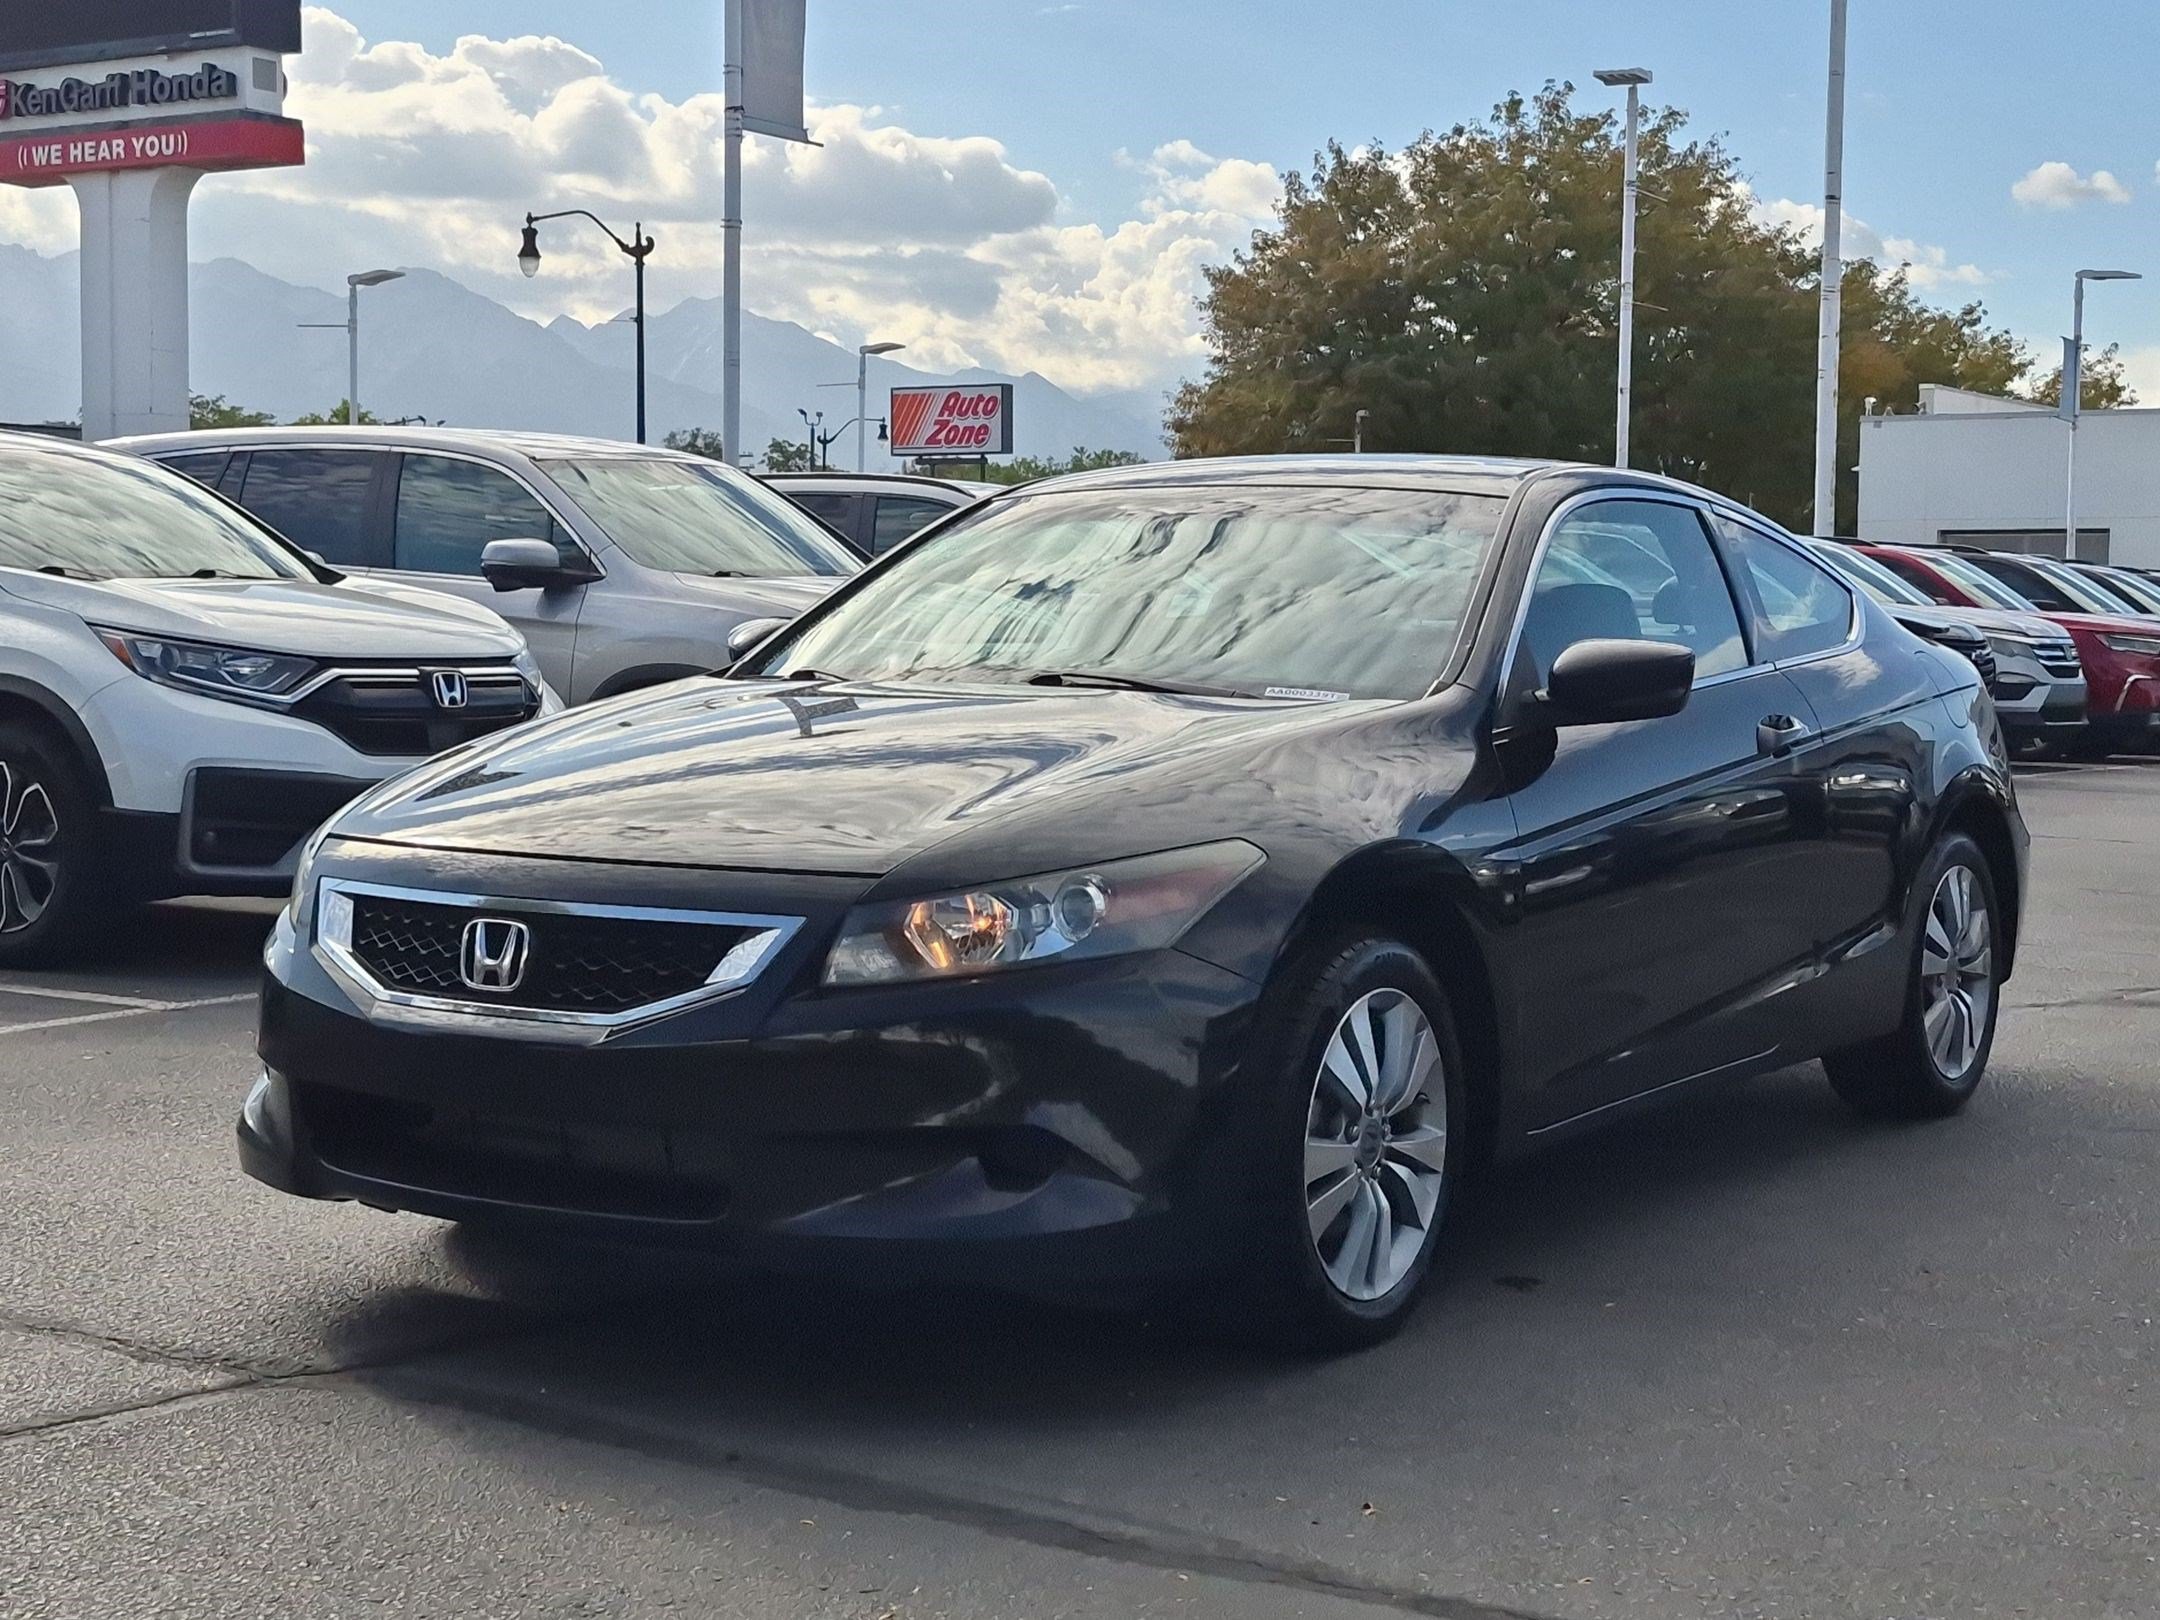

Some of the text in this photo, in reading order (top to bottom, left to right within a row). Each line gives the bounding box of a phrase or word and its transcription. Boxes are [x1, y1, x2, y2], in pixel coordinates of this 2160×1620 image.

[131, 63, 234, 105] Honda
[32, 134, 175, 166] WE HEAR YOU
[938, 391, 999, 418] Auto
[924, 419, 990, 447] Zone
